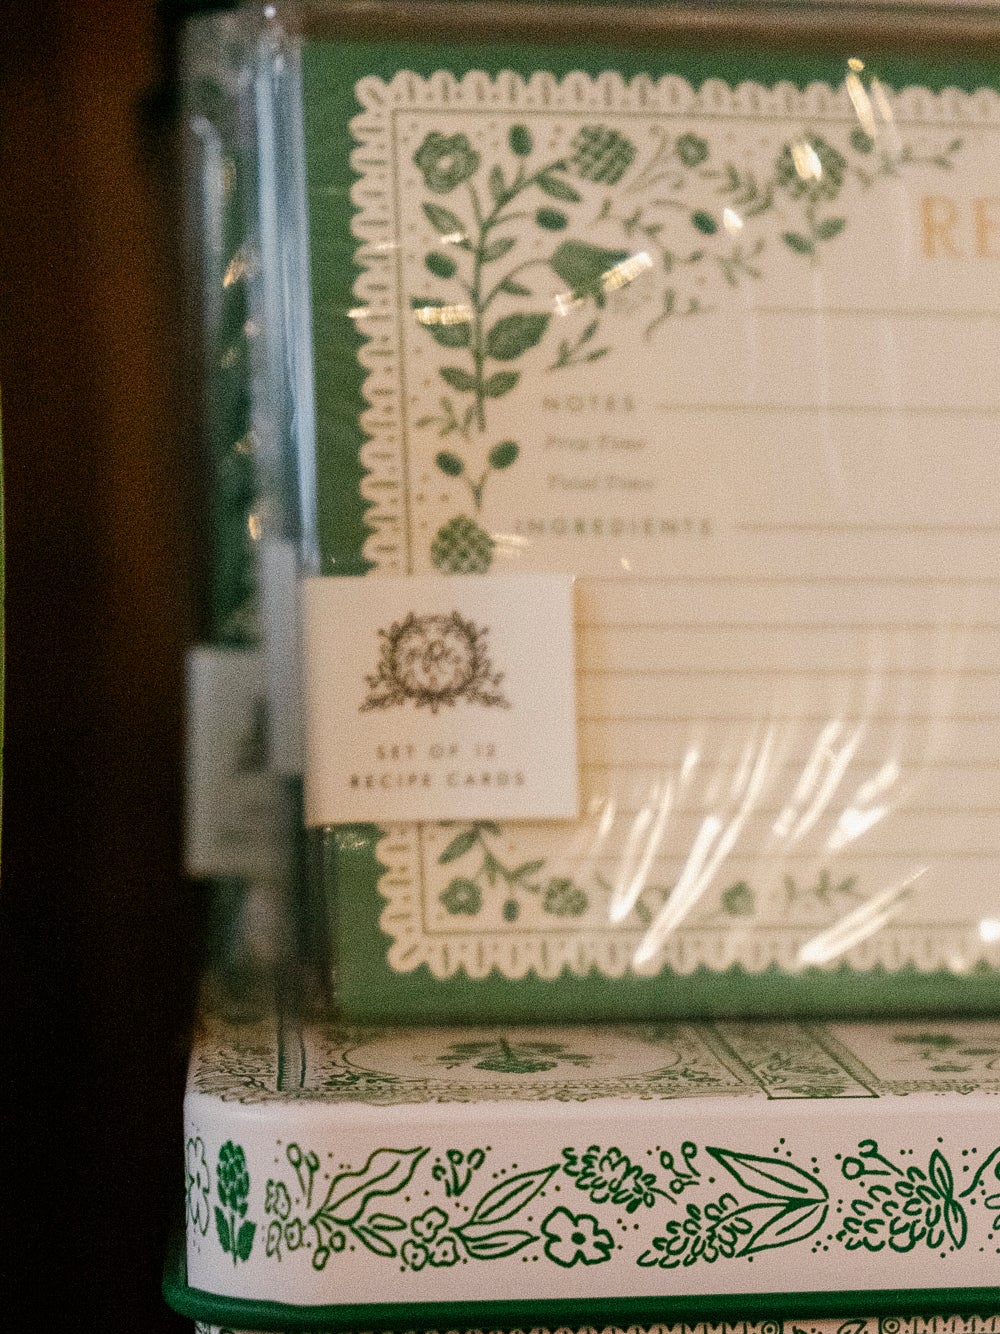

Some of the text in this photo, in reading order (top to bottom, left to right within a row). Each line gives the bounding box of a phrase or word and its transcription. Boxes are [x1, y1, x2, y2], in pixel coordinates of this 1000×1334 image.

[542, 394, 636, 413] NOTES
[514, 516, 713, 536] INGREDIENTS
[375, 743, 497, 760] SET OF 12
[348, 771, 526, 790] RECIPE CARDS
